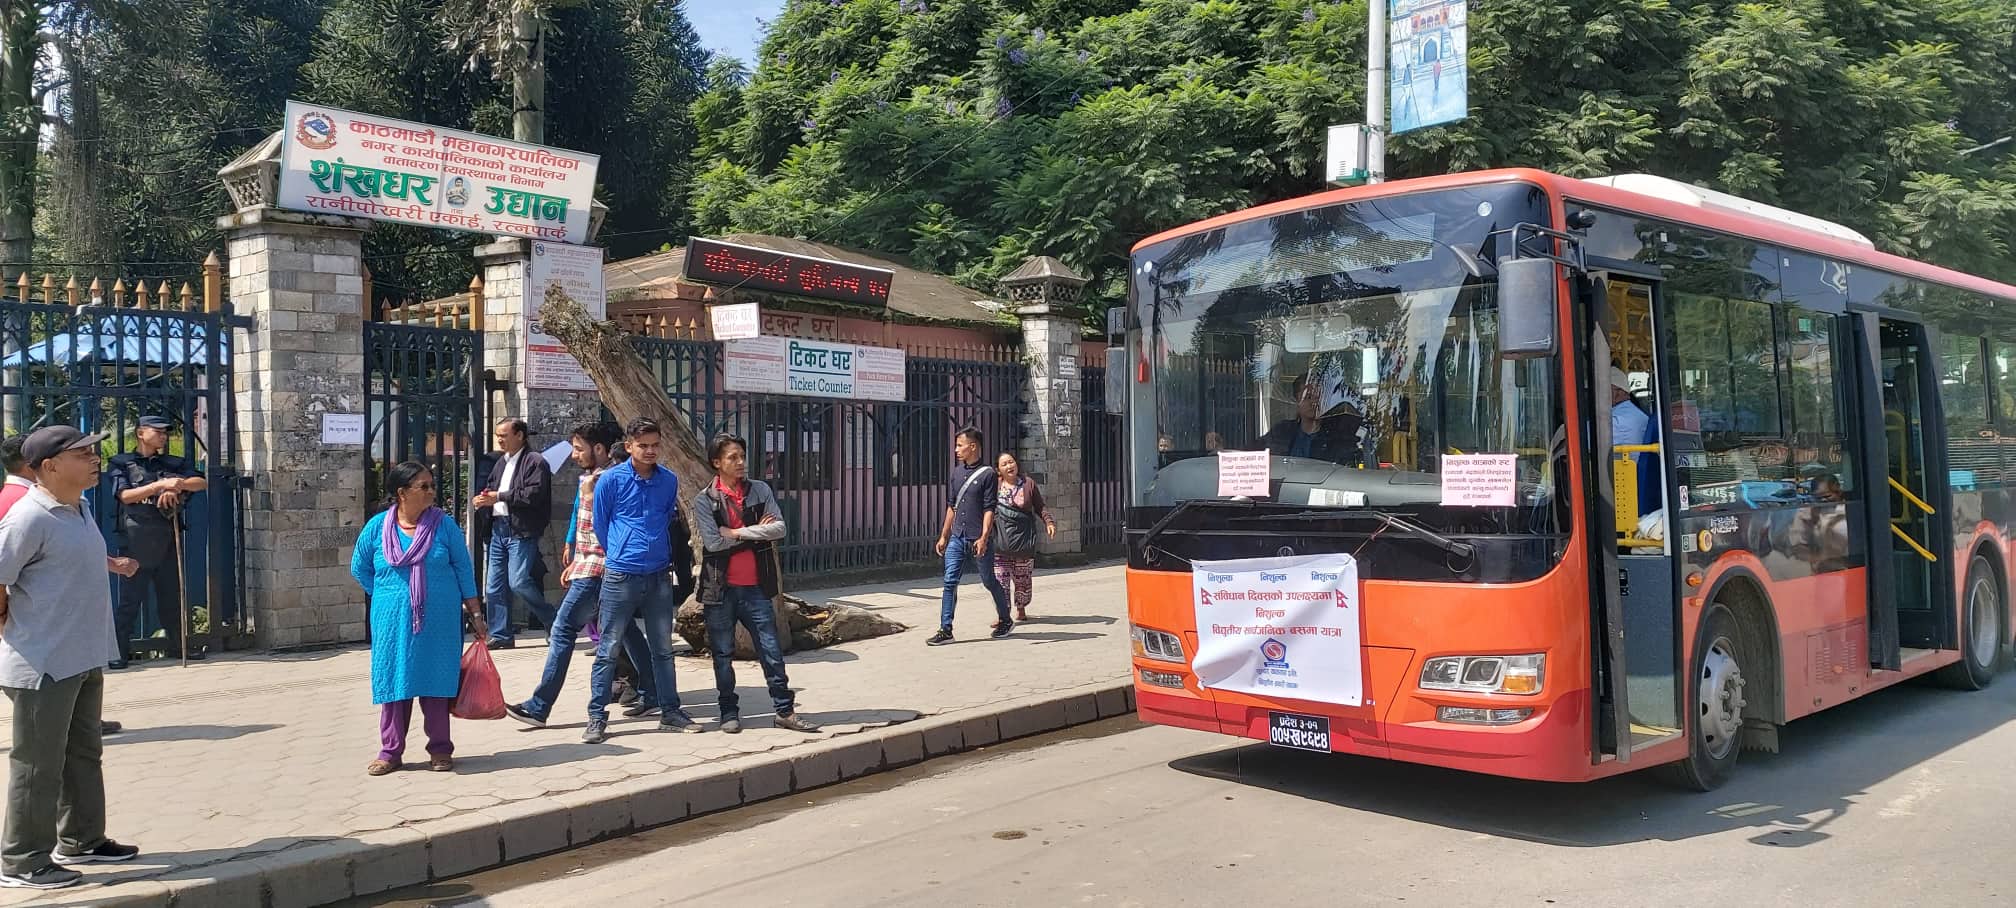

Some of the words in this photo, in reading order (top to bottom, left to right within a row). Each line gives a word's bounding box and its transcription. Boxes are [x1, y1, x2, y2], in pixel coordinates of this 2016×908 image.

[361, 139, 397, 153] नगर
[402, 145, 506, 171] कार्यपालिकाको
[509, 163, 568, 181] कार्यालय
[441, 135, 581, 171] महानगरपालिका
[383, 155, 440, 172] वातावरण
[442, 163, 507, 182] व्यवस्थापन
[510, 173, 545, 189] विभाग
[308, 156, 440, 206] शंखधर
[483, 185, 571, 224] उद्यान
[305, 195, 427, 221] रानीपोखरी
[492, 220, 568, 239] रत्नपार्क
[812, 319, 835, 336] घर
[789, 341, 829, 368] टिकट
[832, 350, 852, 370] घर
[789, 376, 816, 391] Ticket
[818, 378, 852, 393] Counter
[1248, 589, 1282, 601] दिवसको
[1320, 627, 1342, 637] यात्रा
[1279, 715, 1297, 728] प्रदेश
